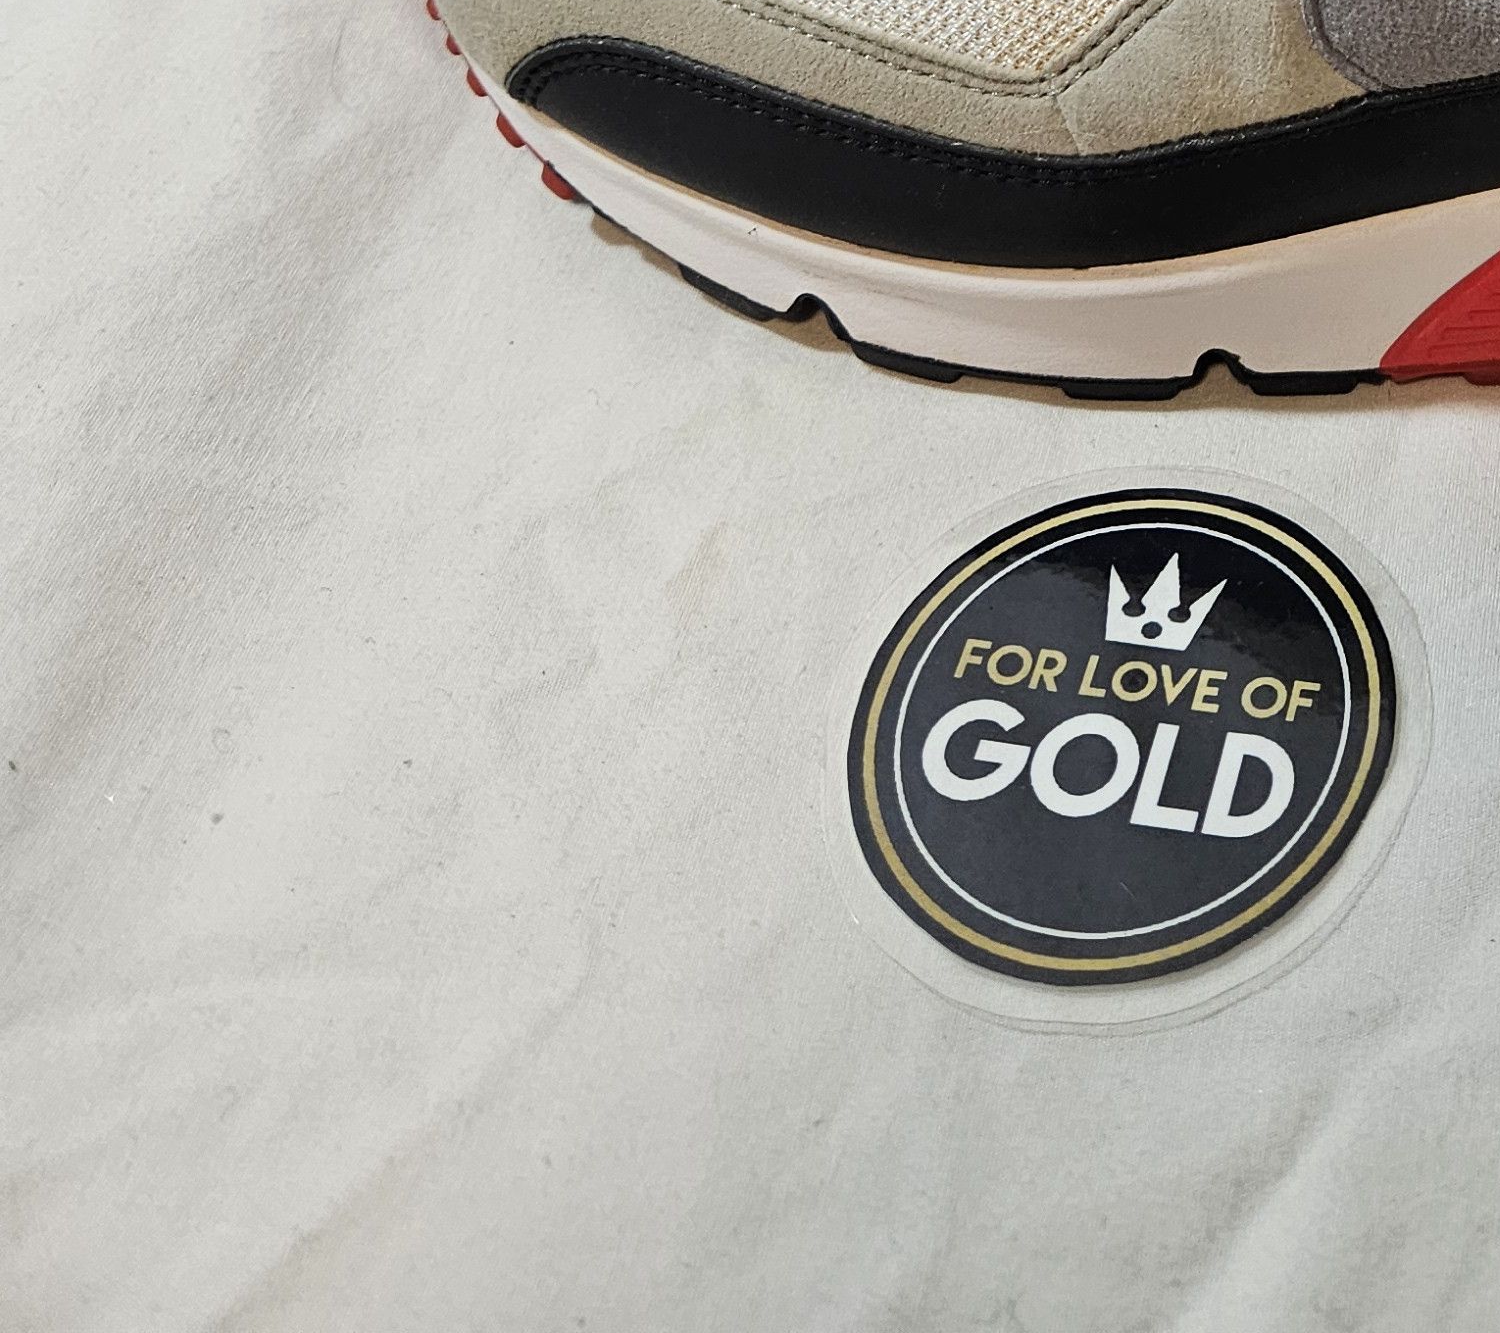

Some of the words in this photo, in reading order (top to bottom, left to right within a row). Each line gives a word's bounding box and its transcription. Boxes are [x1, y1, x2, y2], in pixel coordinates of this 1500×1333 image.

[953, 637, 1068, 693] FOR
[1078, 654, 1228, 715] LOVE
[1240, 676, 1321, 722] OF
[921, 698, 1295, 839] GOLD
